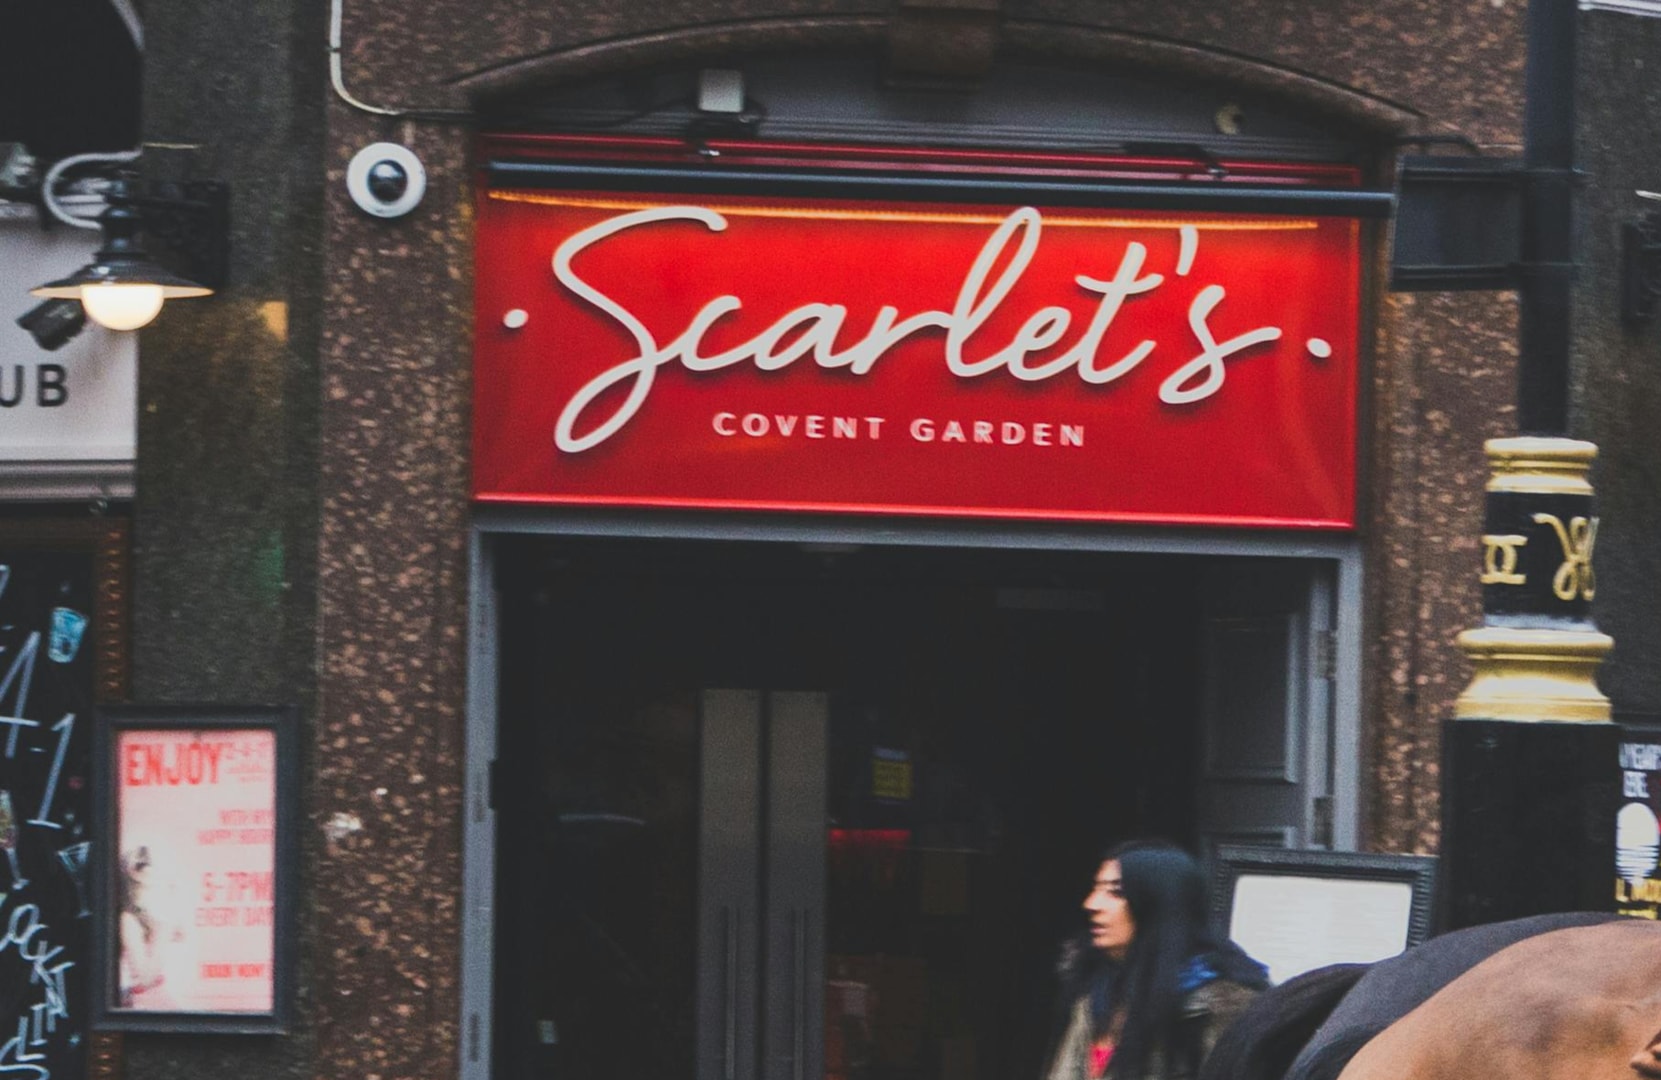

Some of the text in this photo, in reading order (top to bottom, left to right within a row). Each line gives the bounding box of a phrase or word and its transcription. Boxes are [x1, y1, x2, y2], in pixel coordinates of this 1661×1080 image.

[552, 205, 1282, 454] Scarlet's
[712, 411, 1085, 448] COVENT GARDEN
[126, 742, 224, 786] ENJOY
